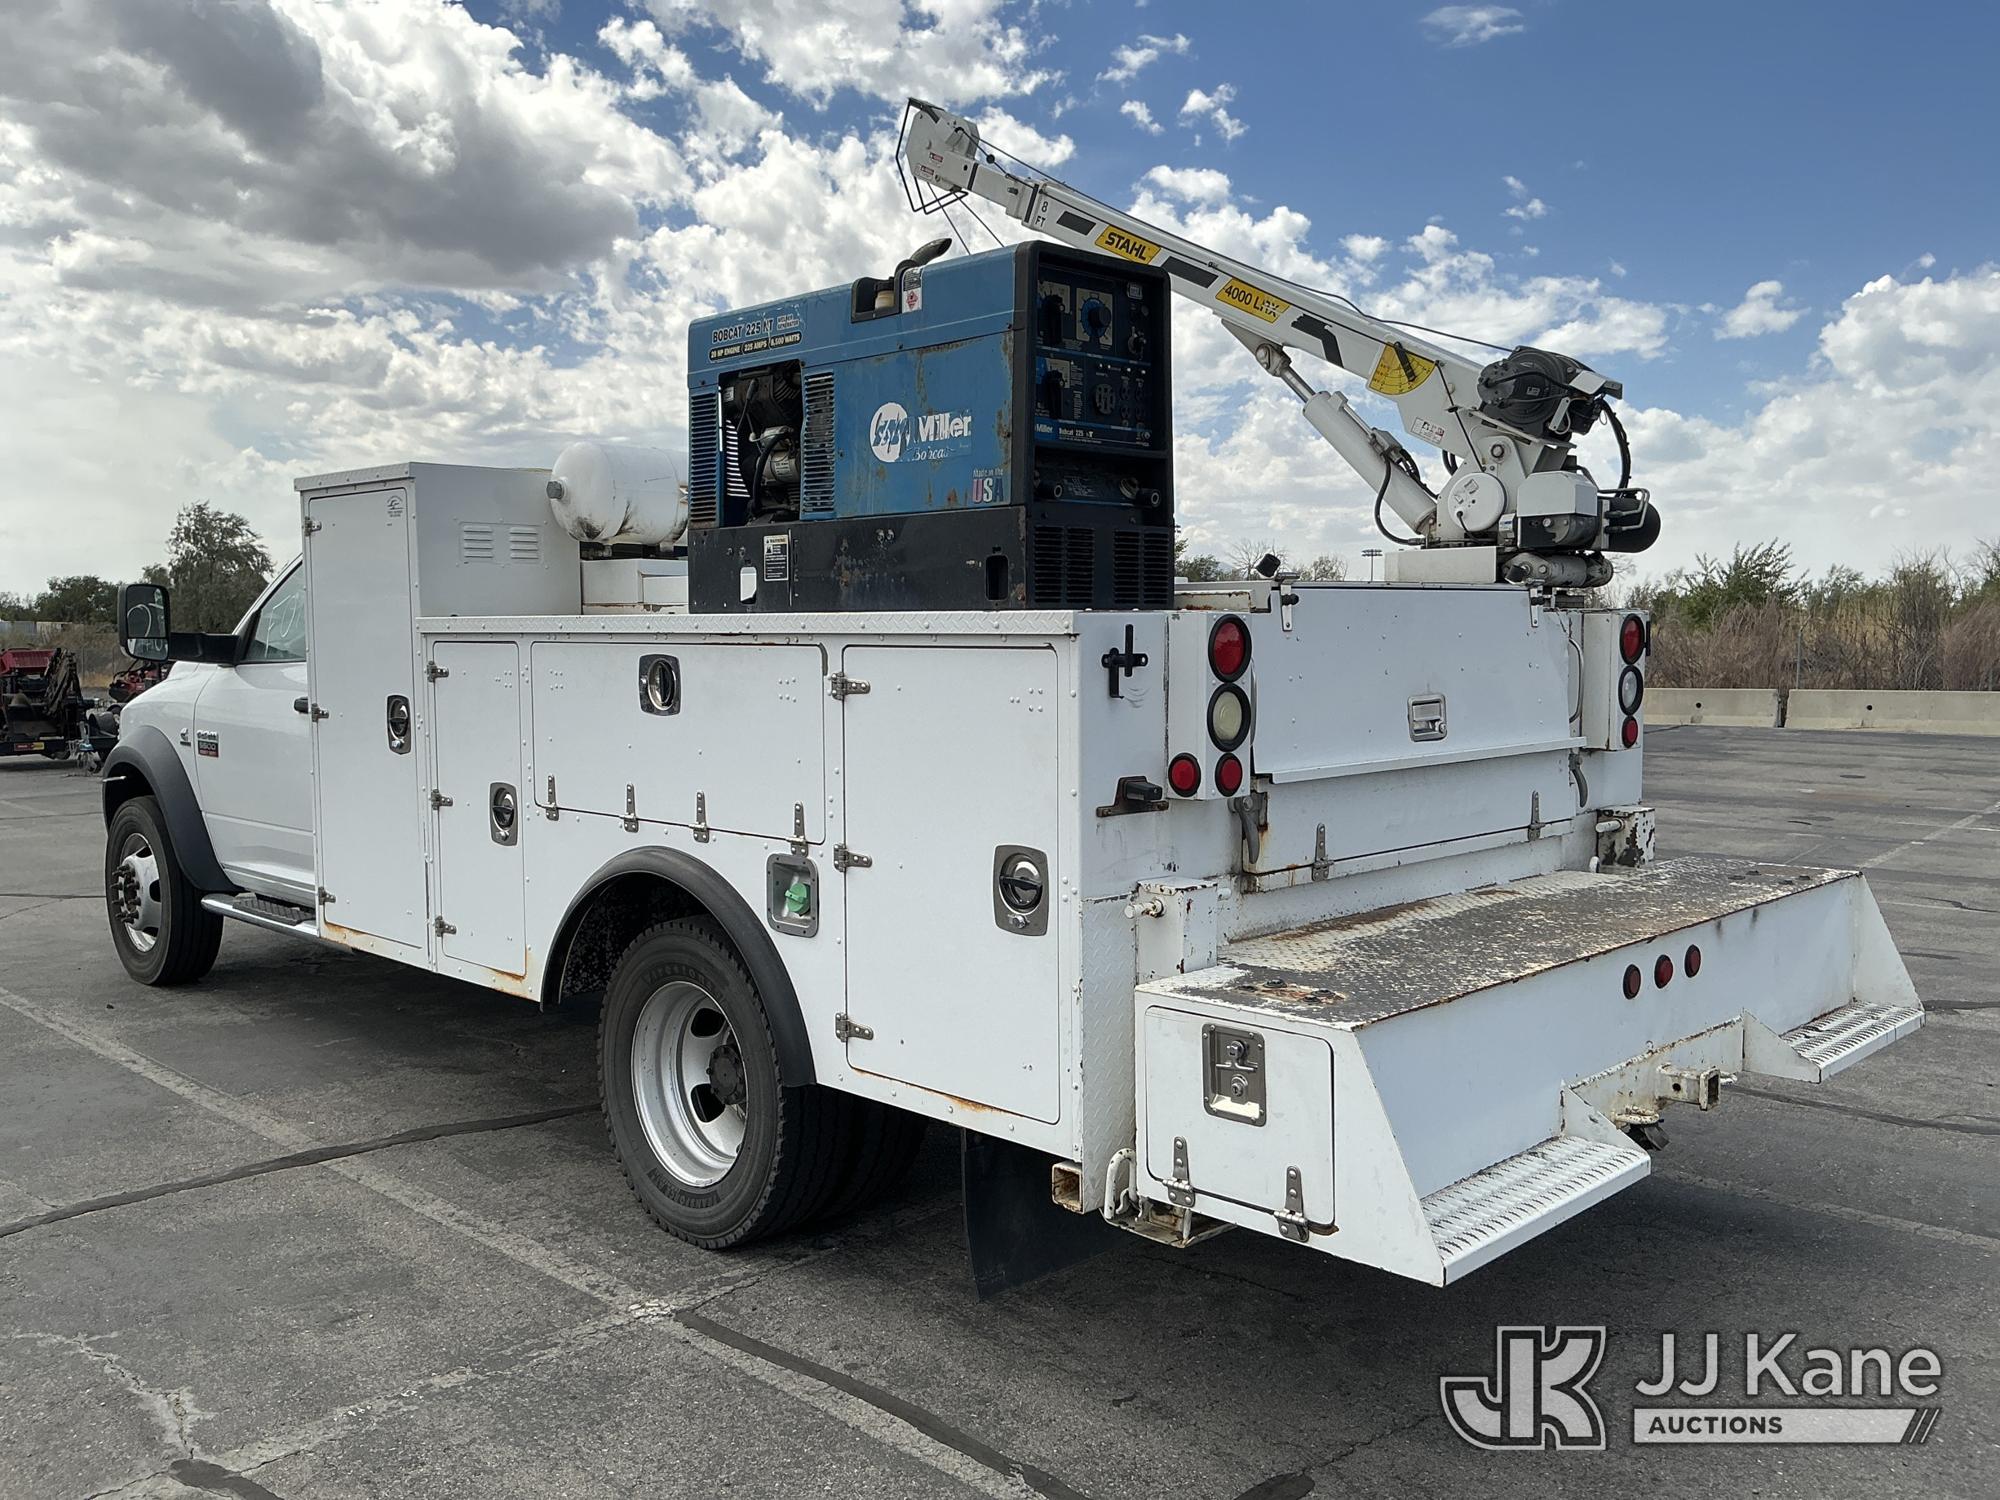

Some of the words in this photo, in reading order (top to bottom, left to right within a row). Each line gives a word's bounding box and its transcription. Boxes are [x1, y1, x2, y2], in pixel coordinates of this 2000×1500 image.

[1041, 201, 1048, 213] 8
[1035, 215, 1046, 227] FT
[1104, 232, 1147, 261] STAHL
[1225, 285, 1252, 306] 4000
[712, 325, 743, 343] BOBCAT
[746, 323, 760, 336] 225
[784, 333, 800, 344] WATTS
[724, 345, 740, 355] ENGINE
[744, 342, 753, 352] 225
[753, 340, 767, 351] AMPS
[918, 412, 972, 443] Miller
[972, 477, 1004, 503] USA
